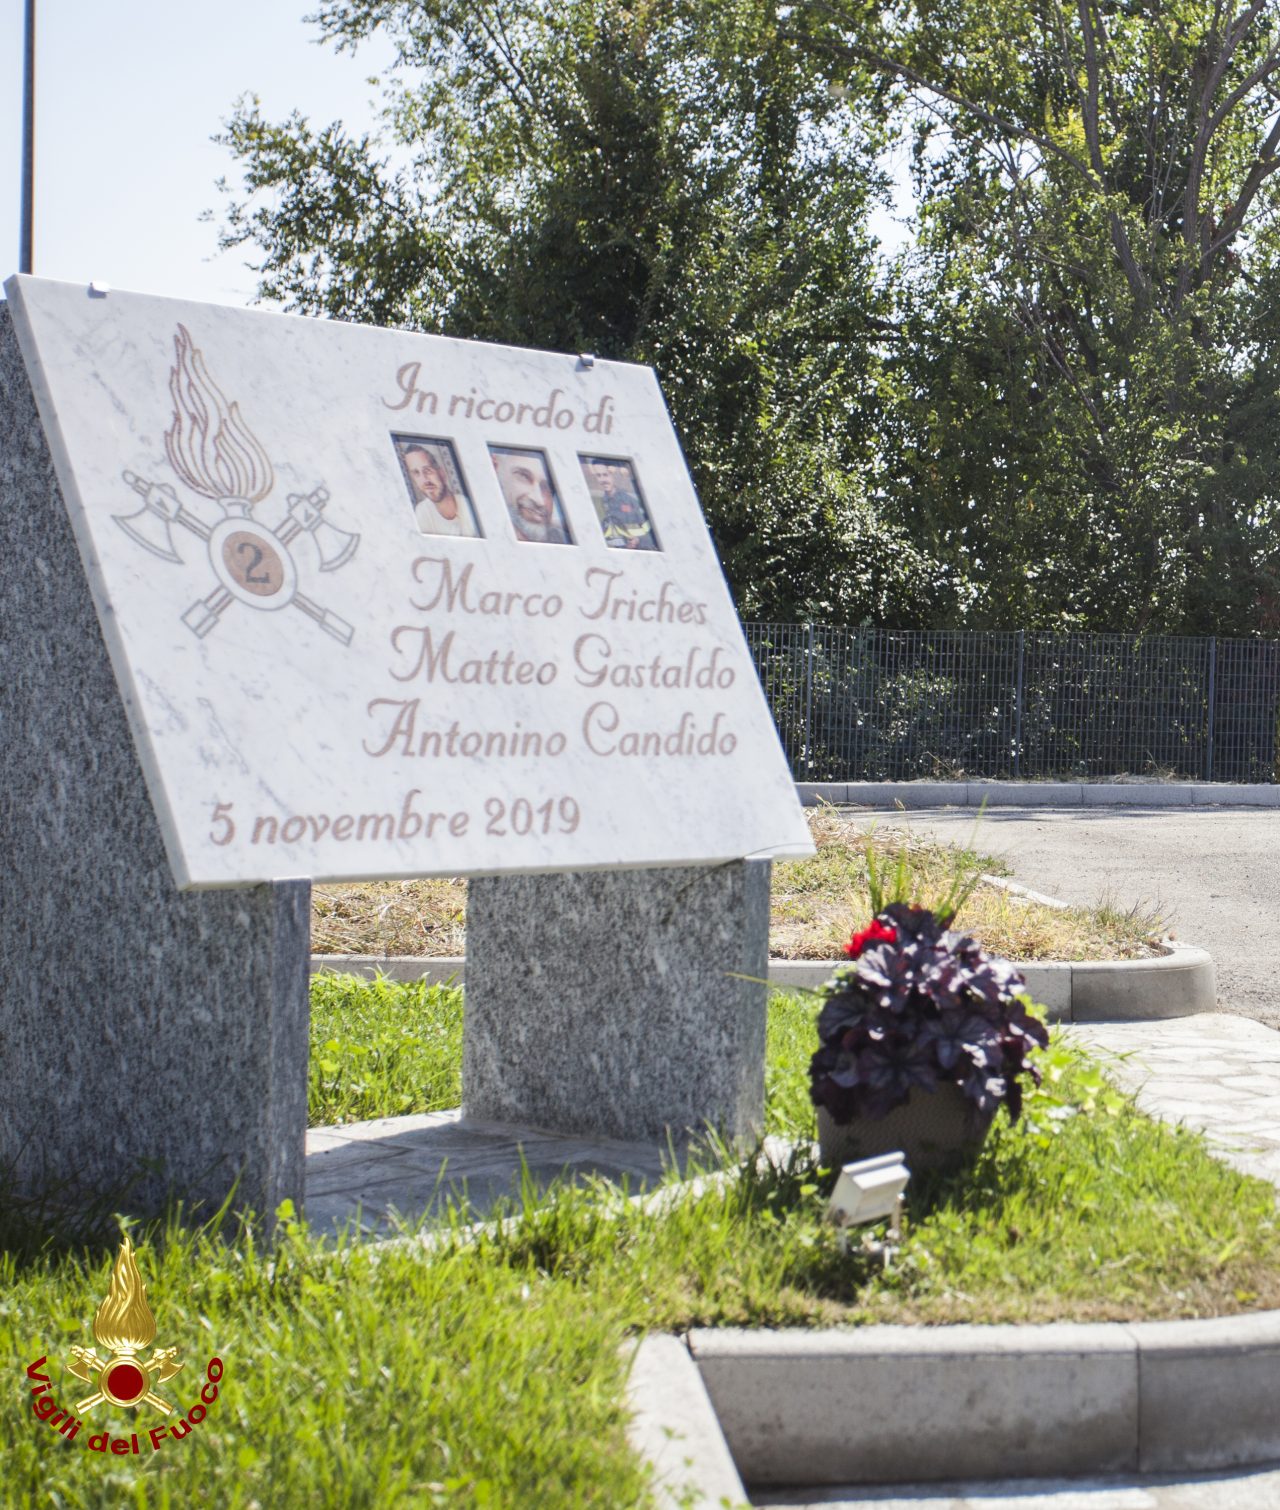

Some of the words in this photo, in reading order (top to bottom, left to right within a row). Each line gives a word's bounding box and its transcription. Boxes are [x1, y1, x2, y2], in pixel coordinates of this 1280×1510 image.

[382, 361, 438, 416] In
[446, 384, 576, 431] ricordo
[583, 395, 615, 436] di
[235, 541, 271, 584] 2
[409, 556, 563, 619] Marco
[579, 566, 708, 626] Triches
[388, 625, 558, 687] Matteo
[573, 633, 736, 691] Gastaldo
[362, 698, 567, 759] Antonino
[582, 701, 738, 757] Candido
[209, 801, 234, 846] 5
[250, 789, 470, 845] novembre
[484, 796, 581, 838] 2019
